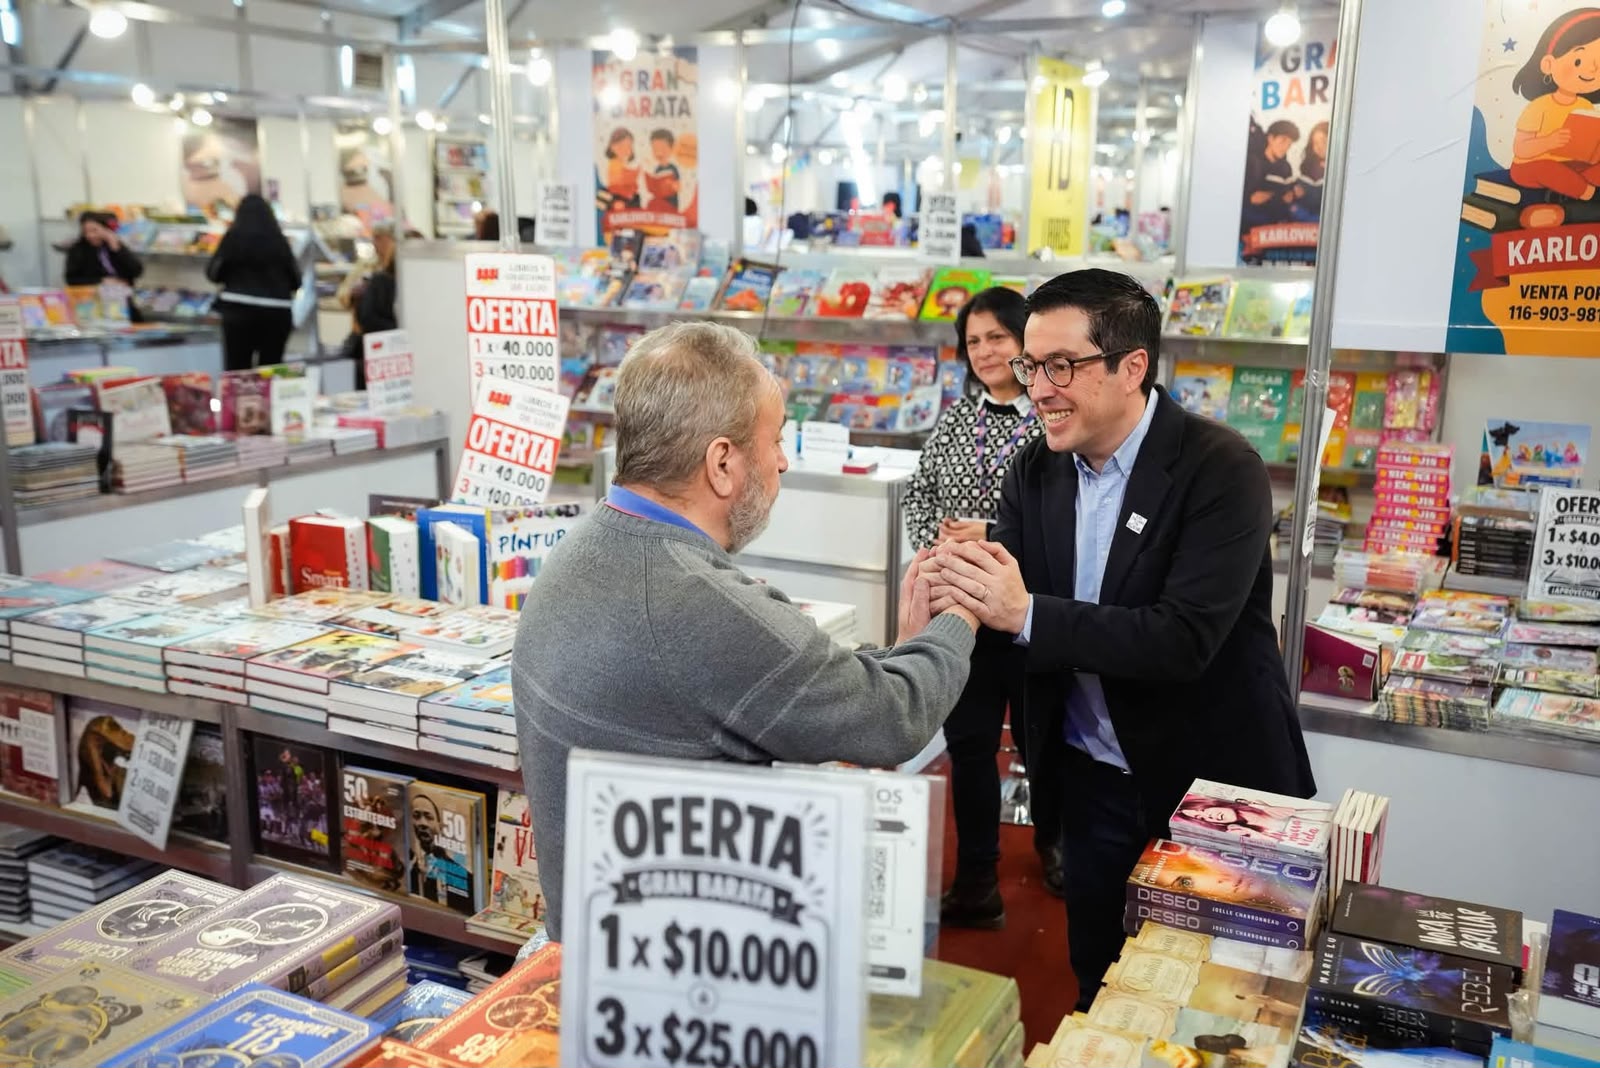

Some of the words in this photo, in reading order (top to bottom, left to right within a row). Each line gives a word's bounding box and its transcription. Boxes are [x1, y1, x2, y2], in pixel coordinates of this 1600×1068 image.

[619, 69, 679, 91] GRAN
[1520, 285, 1568, 300] VENTA
[469, 298, 556, 335] OFERTA
[0, 339, 27, 368] TA
[474, 339, 481, 354] 1
[503, 341, 553, 357] 40.000
[475, 362, 484, 377] 3
[502, 365, 554, 381] 100.000
[468, 417, 552, 475] OFERTA
[460, 478, 470, 493] 3
[466, 457, 475, 472] 1
[496, 465, 545, 492] 40.000
[1556, 496, 1600, 514] OFER
[1548, 527, 1556, 542] 1
[1559, 533, 1566, 542] x
[1544, 549, 1555, 565] 3
[1556, 558, 1563, 566] x
[1566, 553, 1600, 569] $10.0
[344, 774, 368, 808] 50
[442, 810, 466, 841] 50
[613, 797, 803, 879] OFERTA
[639, 870, 693, 897] GRAN
[700, 873, 775, 912] BARATA
[1138, 888, 1200, 911] DESEO
[1212, 906, 1233, 917] JOELLE
[1138, 906, 1200, 929] DESEO
[1212, 924, 1233, 935] JOELLE
[1457, 907, 1502, 954] BRILLAR
[600, 913, 620, 970] 1
[631, 934, 650, 967] x
[663, 920, 818, 991] $10.000
[1319, 952, 1335, 985] MARIE
[1330, 936, 1338, 950] LU
[1461, 966, 1499, 1013] REBEL
[594, 996, 626, 1057] 3
[635, 1025, 652, 1058] x
[662, 1011, 818, 1068] $25.000
